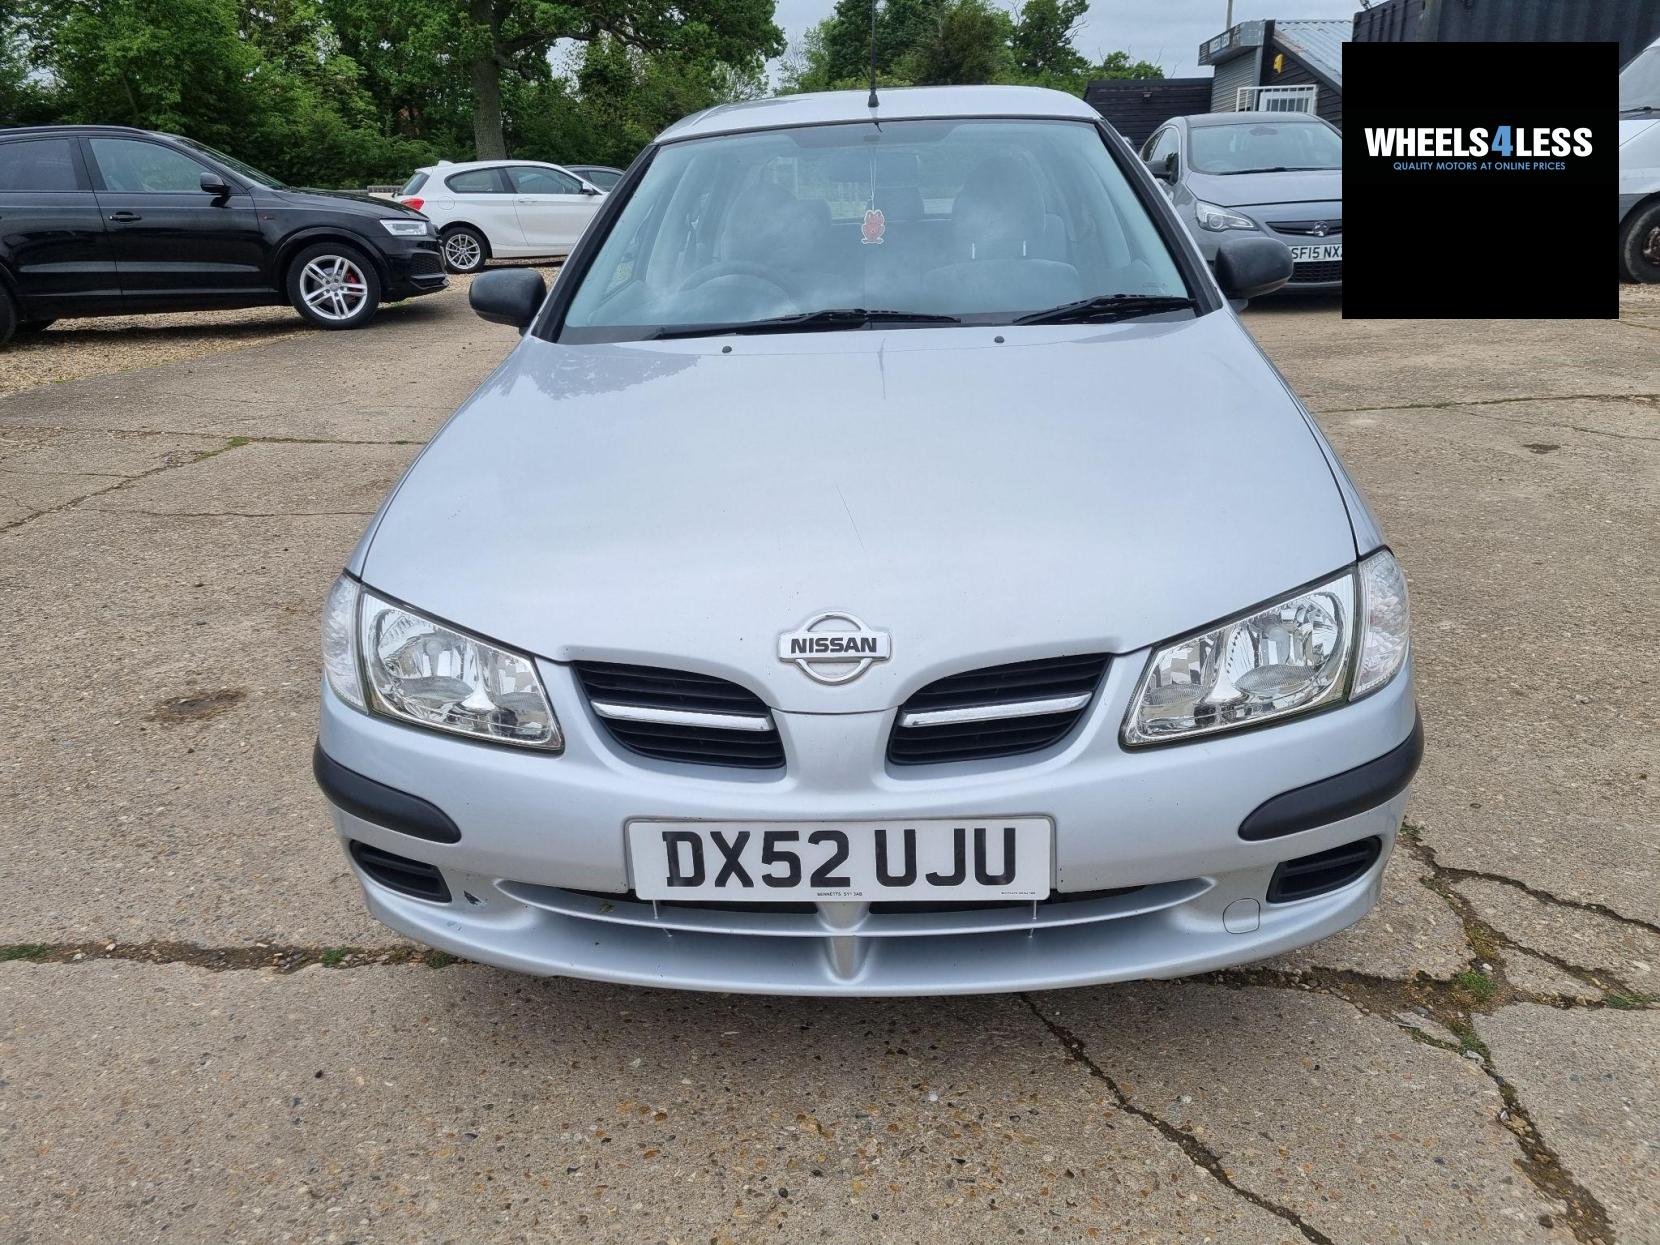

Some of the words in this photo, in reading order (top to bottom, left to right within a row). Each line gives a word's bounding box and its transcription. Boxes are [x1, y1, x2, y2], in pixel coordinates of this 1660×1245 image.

[1291, 246, 1321, 259] SF15
[1323, 245, 1342, 258] NX
[790, 637, 877, 654] NISSAN
[661, 829, 851, 888] DX52
[874, 827, 1016, 888] UJU
